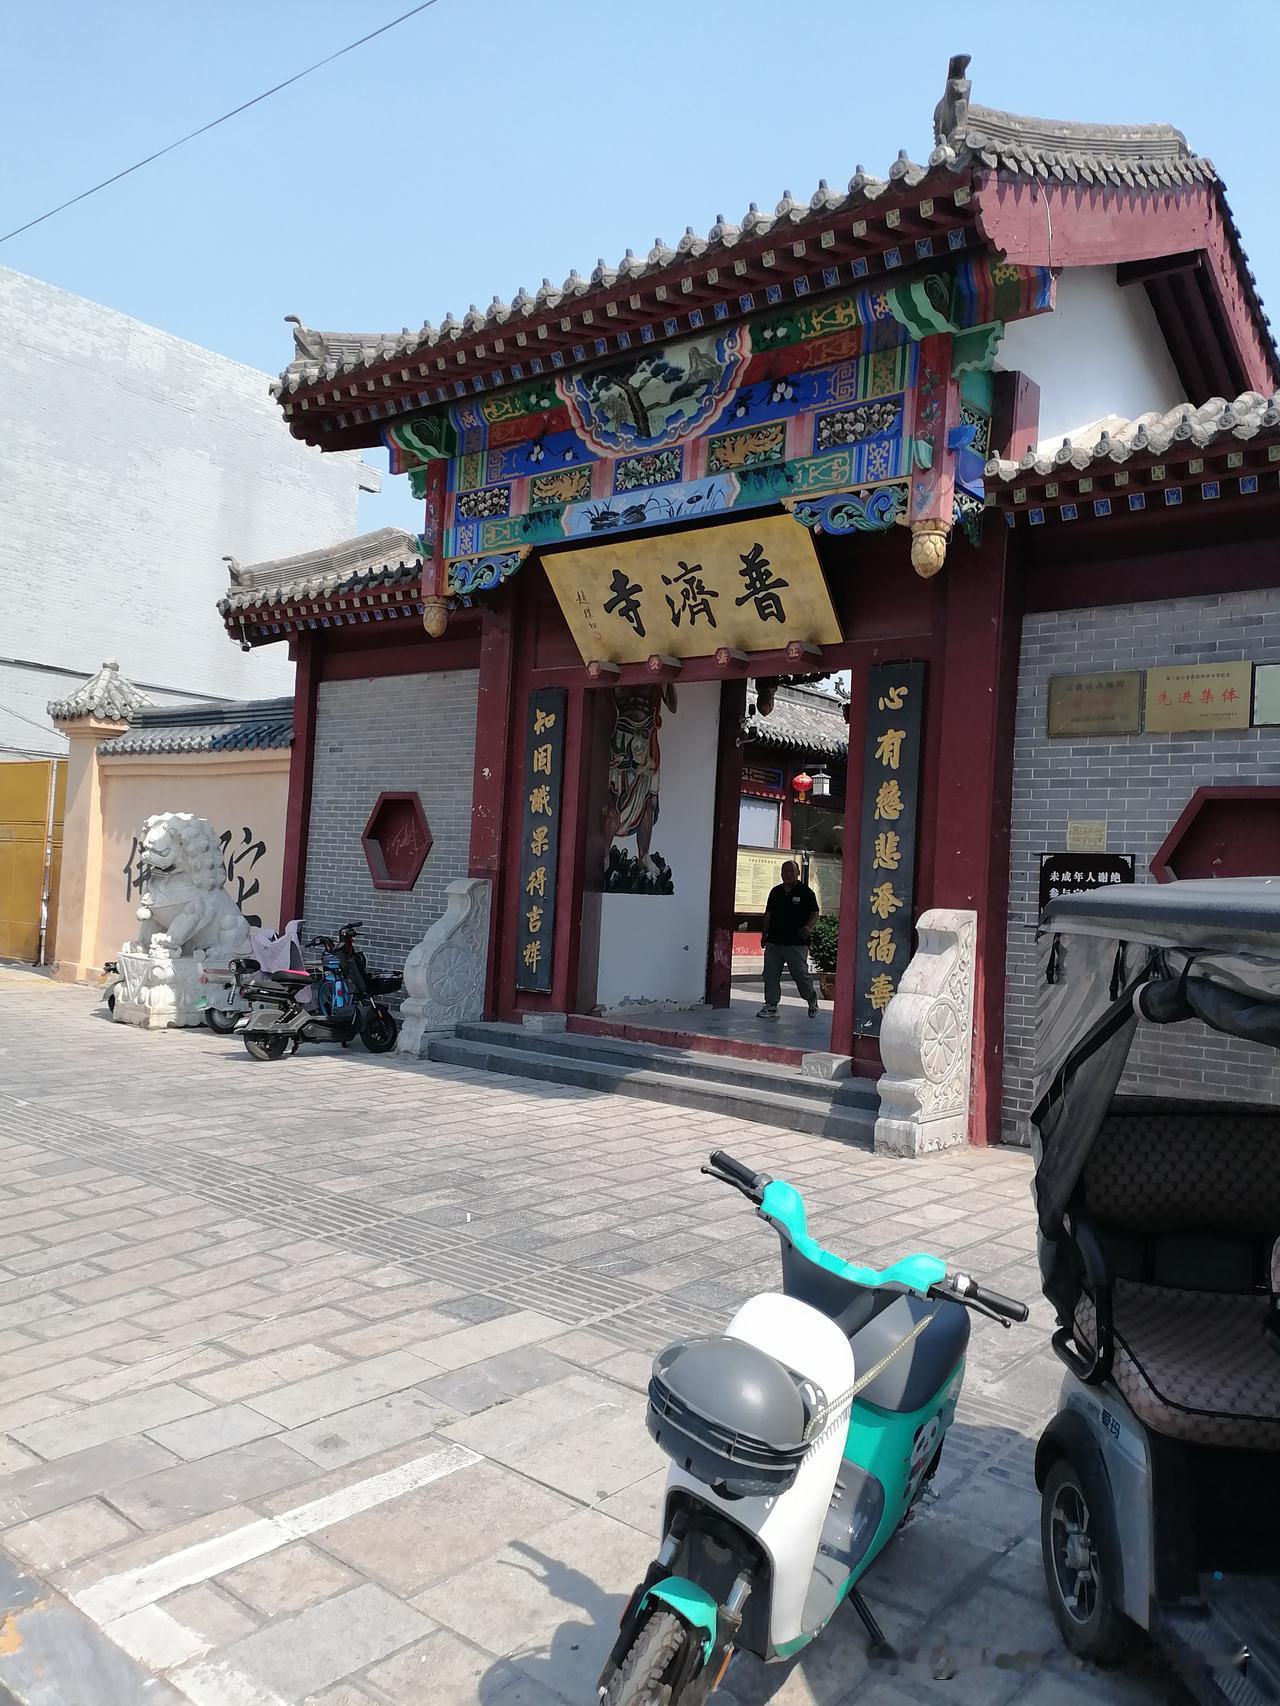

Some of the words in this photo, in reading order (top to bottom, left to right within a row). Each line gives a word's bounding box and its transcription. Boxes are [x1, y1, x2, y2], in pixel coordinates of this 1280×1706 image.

[603, 542, 789, 638] 普濟寺
[1158, 687, 1240, 706] 先进集体
[1049, 870, 1121, 883] 未成年人谢绝
